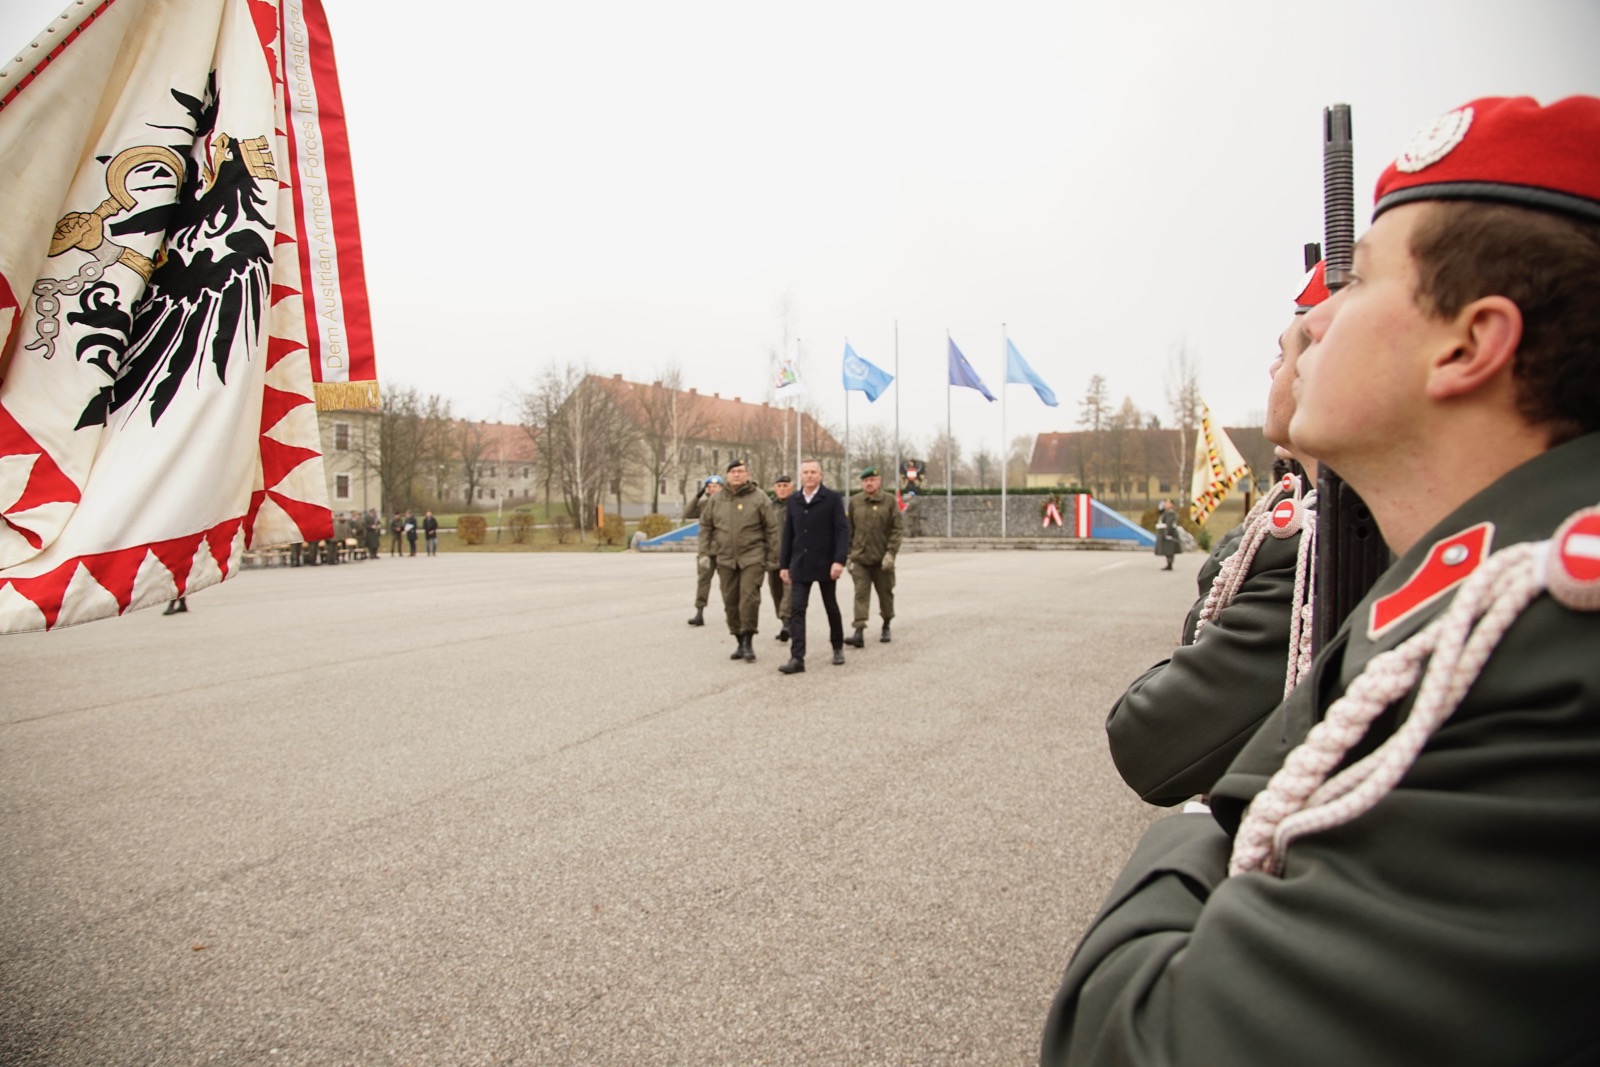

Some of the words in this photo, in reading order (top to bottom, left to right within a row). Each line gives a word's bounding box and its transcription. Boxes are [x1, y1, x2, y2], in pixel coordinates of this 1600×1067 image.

[289, 3, 312, 114] International
[303, 121, 320, 179] Forces
[308, 185, 328, 244] Armed
[317, 250, 338, 322] Austrian
[326, 327, 343, 369] Dem
